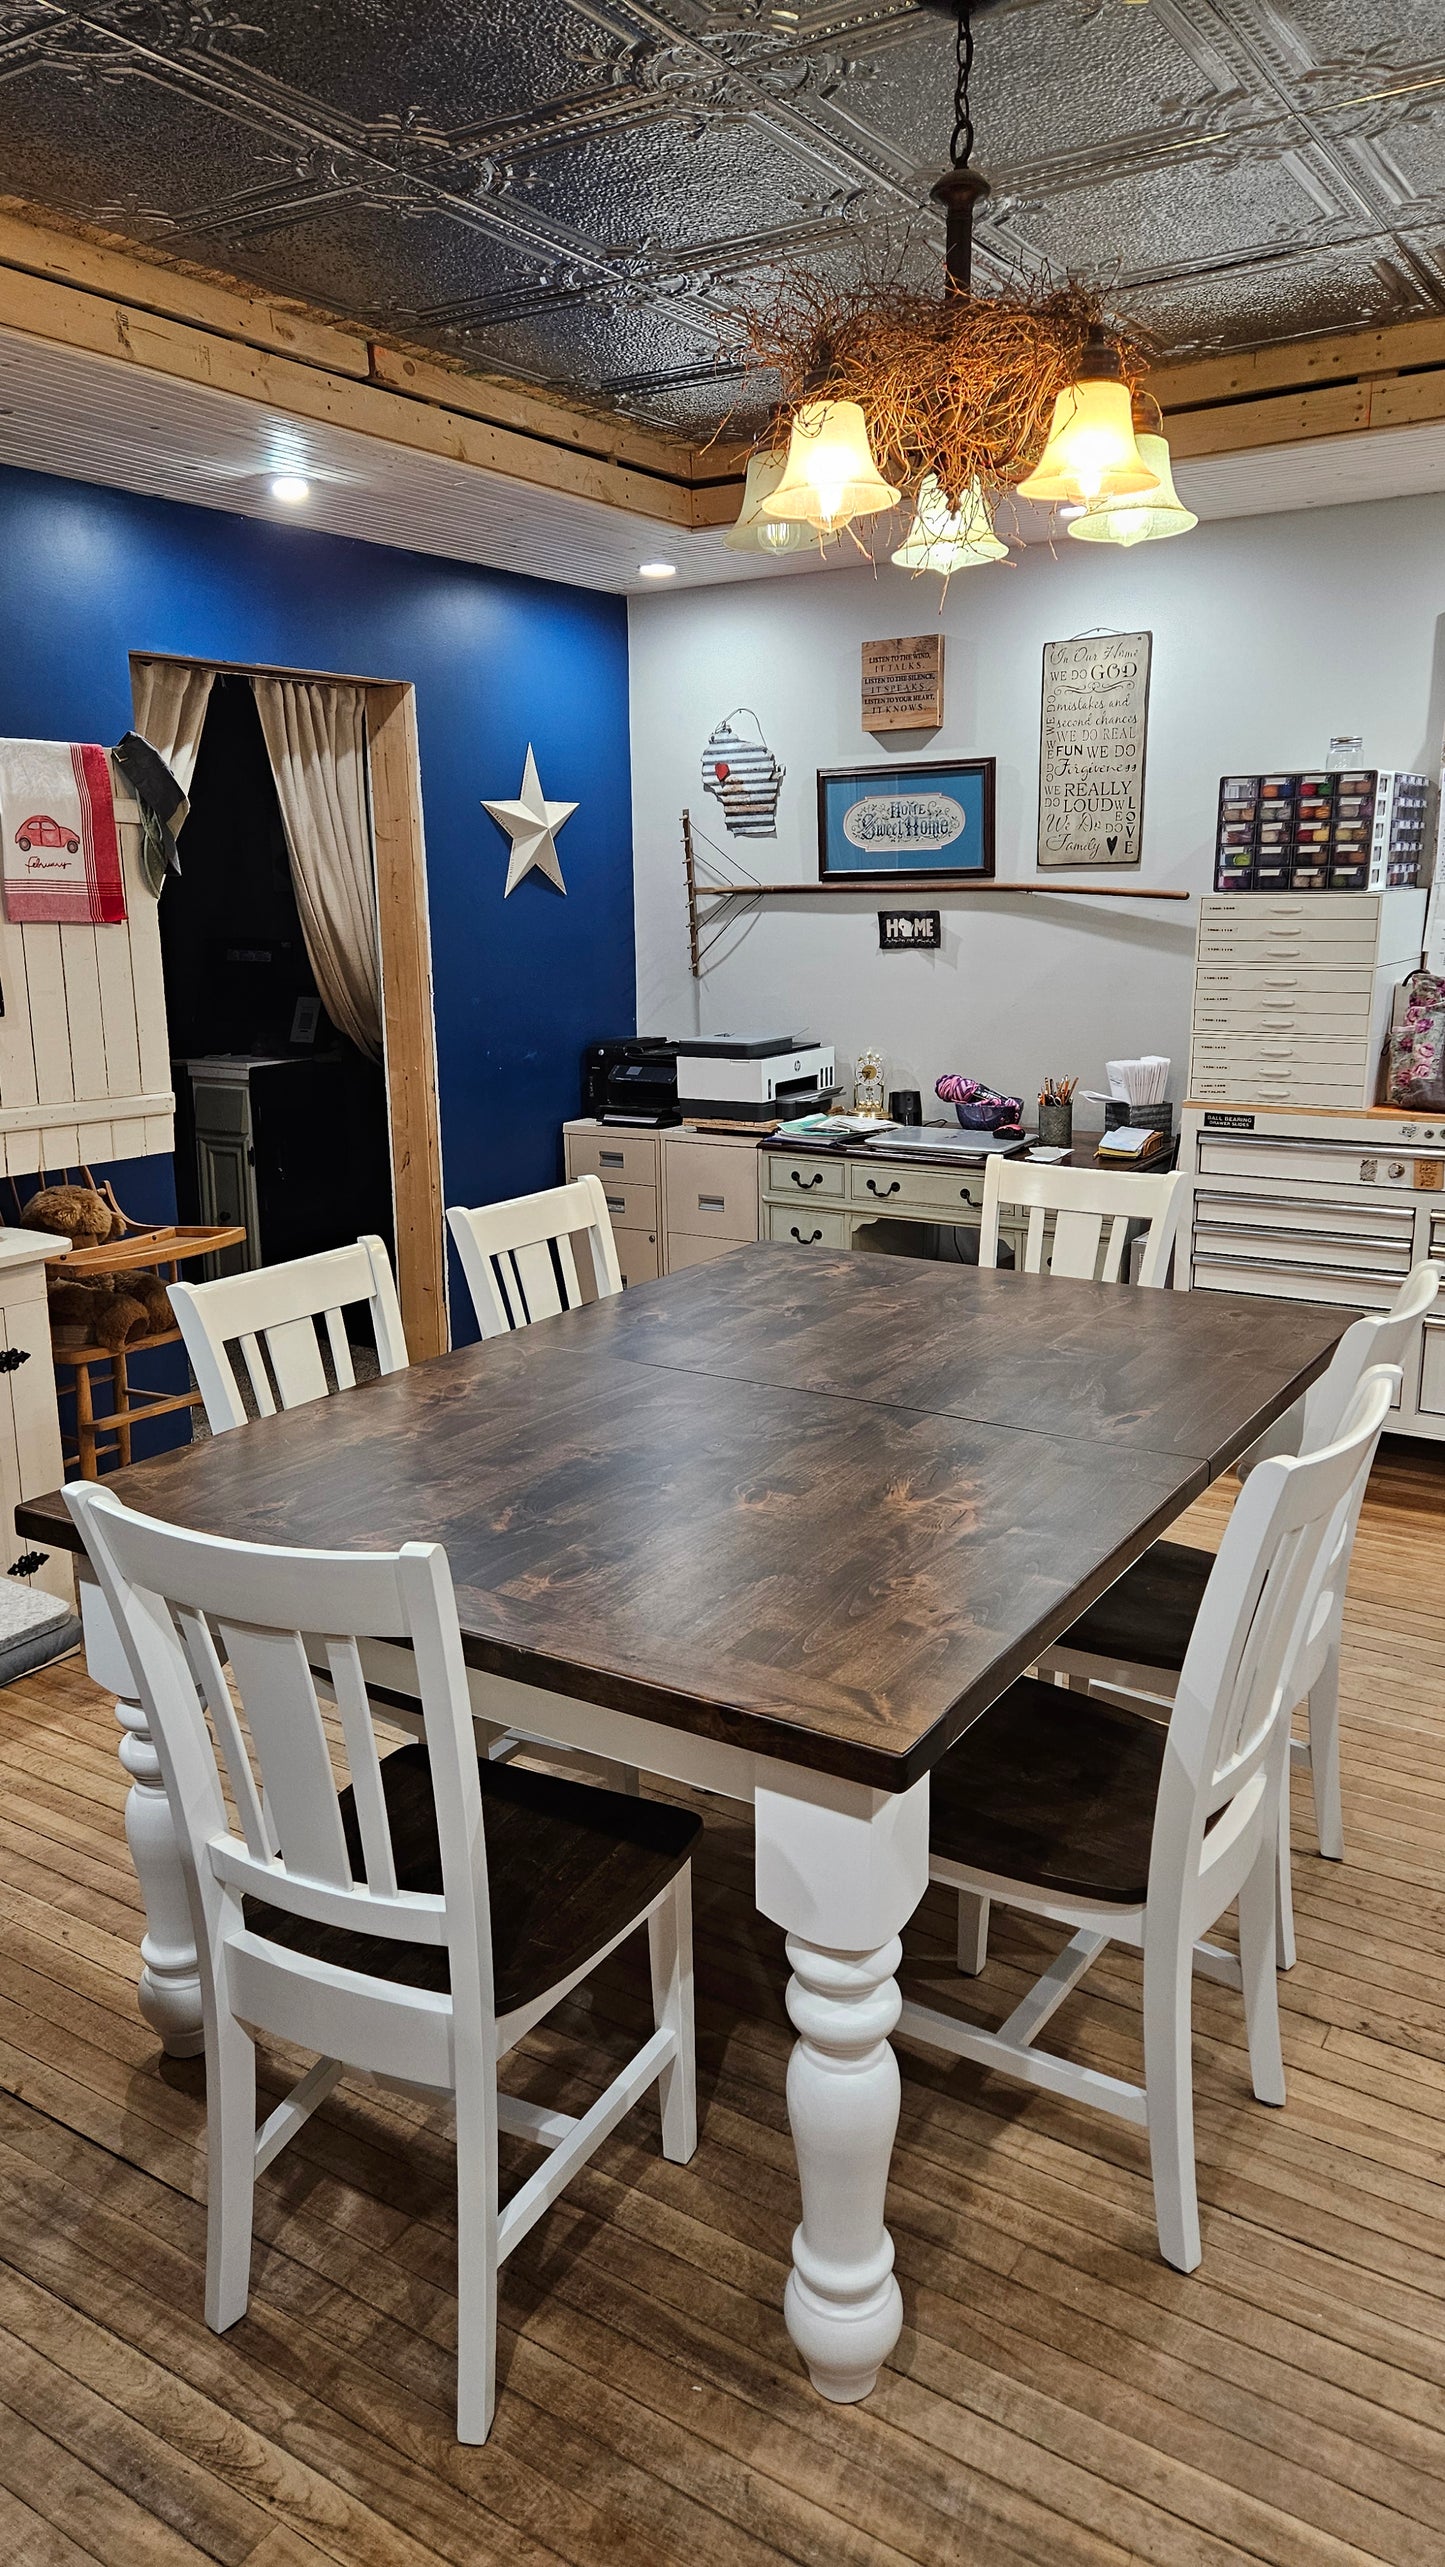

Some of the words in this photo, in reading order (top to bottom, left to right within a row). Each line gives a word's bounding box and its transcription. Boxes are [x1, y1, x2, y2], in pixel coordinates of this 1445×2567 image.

[869, 655, 889, 663] LISTEN
[900, 653, 911, 661] THE
[1050, 647, 1068, 665] In
[1074, 647, 1097, 662] Our
[1104, 642, 1138, 659] Home
[875, 664, 884, 672] IT
[888, 662, 925, 671] TALKS.
[1050, 671, 1067, 681] WE
[1071, 669, 1088, 680] DO
[1091, 662, 1137, 680] GOD
[896, 674, 907, 682] THE
[895, 695, 912, 703] YOUR
[1056, 696, 1104, 711] mistakes
[1109, 693, 1131, 708] and
[872, 706, 882, 714] IT
[886, 703, 926, 713] KNOWS.
[1057, 712, 1092, 728] second
[1095, 711, 1137, 725] chances
[1056, 730, 1077, 743] WE
[1082, 729, 1098, 742] DO
[1103, 727, 1136, 740] REAL
[1056, 745, 1083, 756] FUN
[1087, 746, 1109, 758] WE
[1115, 744, 1136, 757] DO
[1054, 758, 1137, 781] Forgiveness
[1044, 785, 1061, 795] WE
[1064, 780, 1132, 797] REALLY
[890, 801, 926, 819] HOME
[1044, 797, 1060, 807] DO
[1063, 797, 1113, 813] LOUD
[862, 813, 903, 840] Sweet
[904, 815, 949, 838] Home
[1046, 813, 1072, 833] We
[1105, 823, 1123, 833] DO
[1046, 833, 1100, 860] Family
